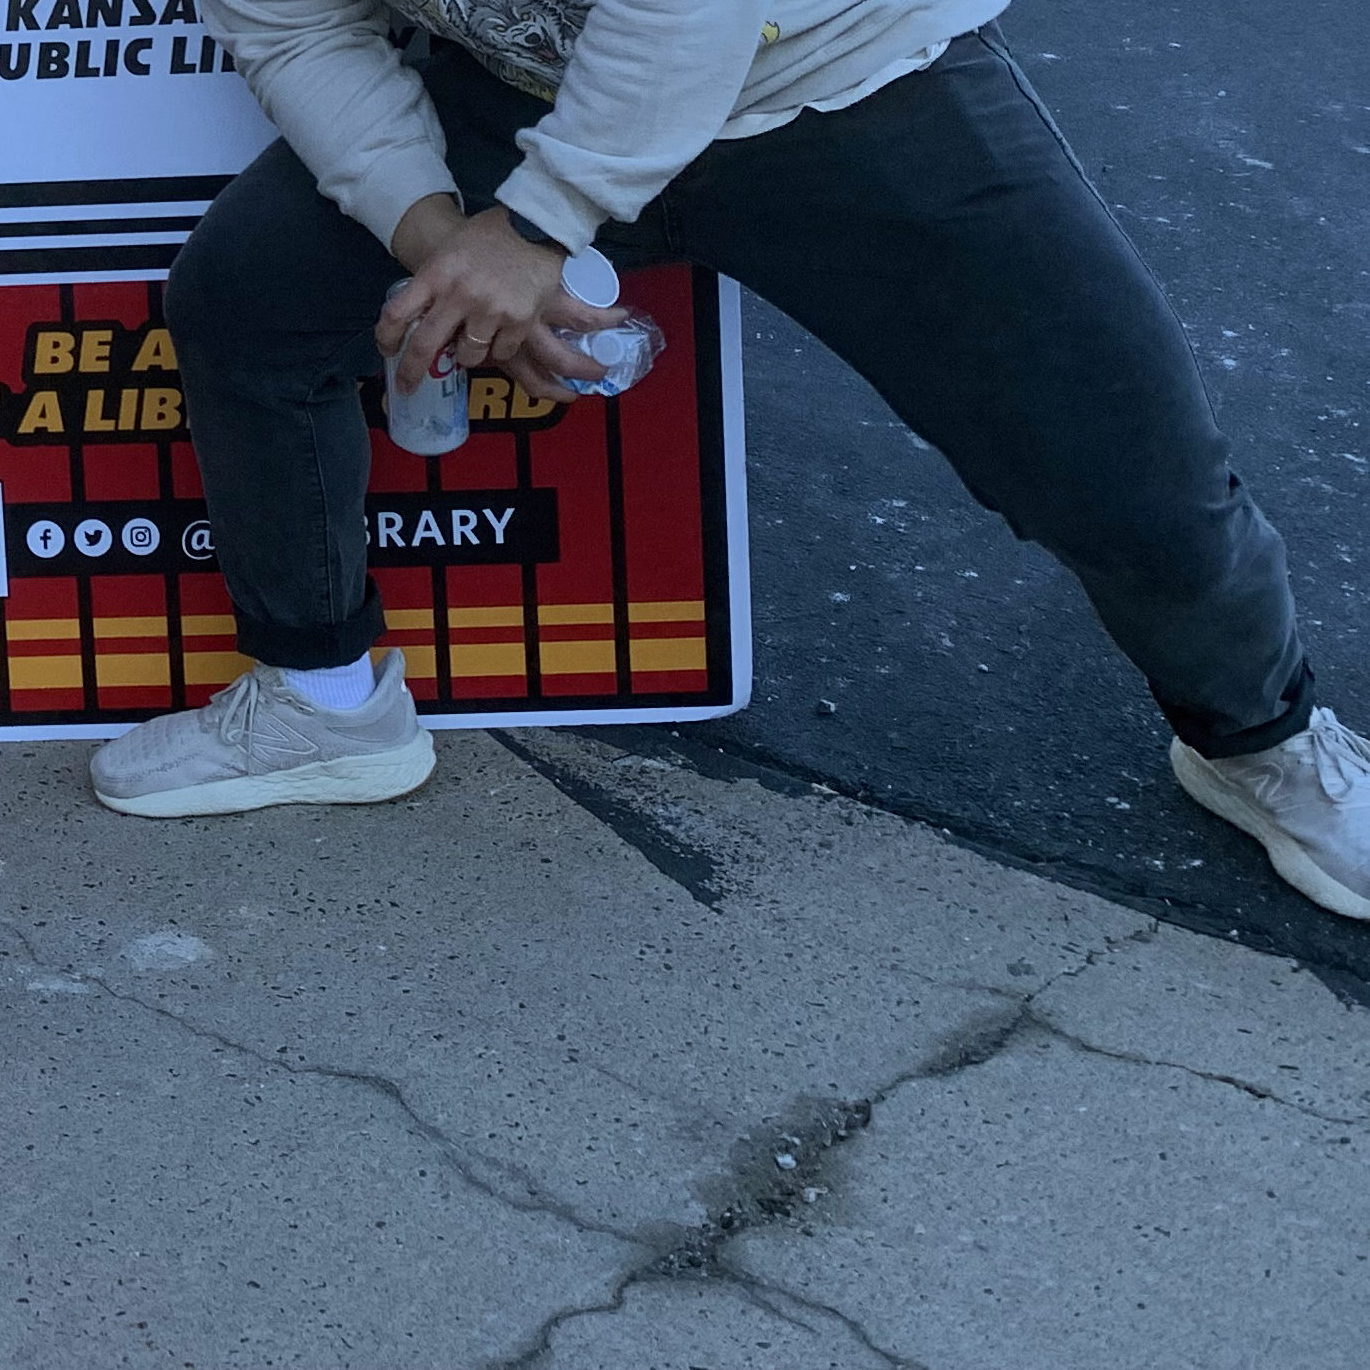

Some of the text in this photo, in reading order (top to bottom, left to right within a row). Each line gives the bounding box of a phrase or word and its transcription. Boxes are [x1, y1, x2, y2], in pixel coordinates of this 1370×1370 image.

[33, 329, 113, 374] BE
[17, 390, 65, 434] A
[83, 387, 190, 431] LIB
